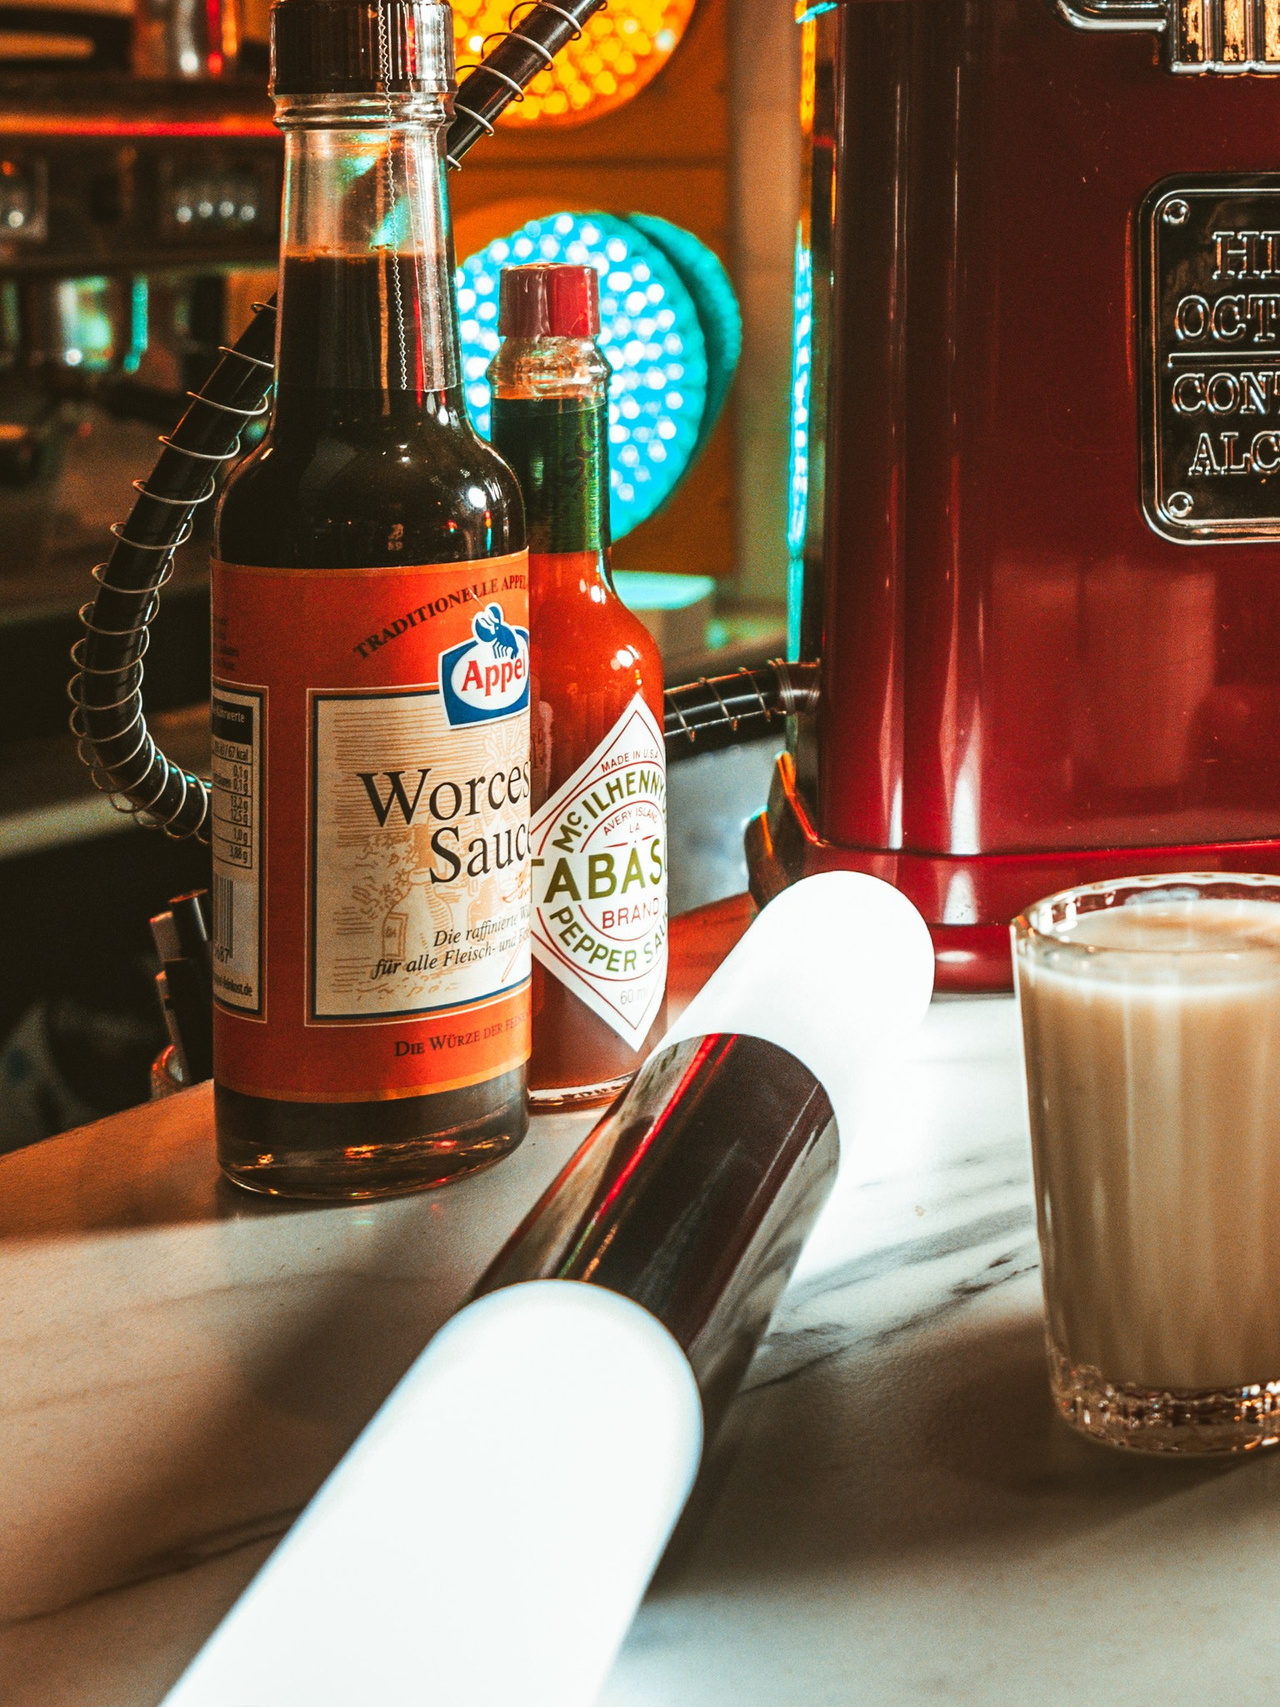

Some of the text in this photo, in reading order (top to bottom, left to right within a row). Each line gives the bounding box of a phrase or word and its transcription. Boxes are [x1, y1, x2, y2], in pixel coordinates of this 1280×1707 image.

[353, 577, 499, 659] TRADITIONELLE
[461, 649, 526, 697] Appel
[601, 752, 630, 773] MADE
[632, 749, 641, 761] IN
[603, 809, 632, 836] AVERY
[433, 928, 464, 948] Die
[466, 914, 518, 942] raffinierte
[602, 897, 660, 929] BRAND
[549, 905, 637, 972] PEPPER
[371, 958, 402, 980] für
[406, 953, 438, 973] alle
[442, 942, 496, 968] Fleisch-
